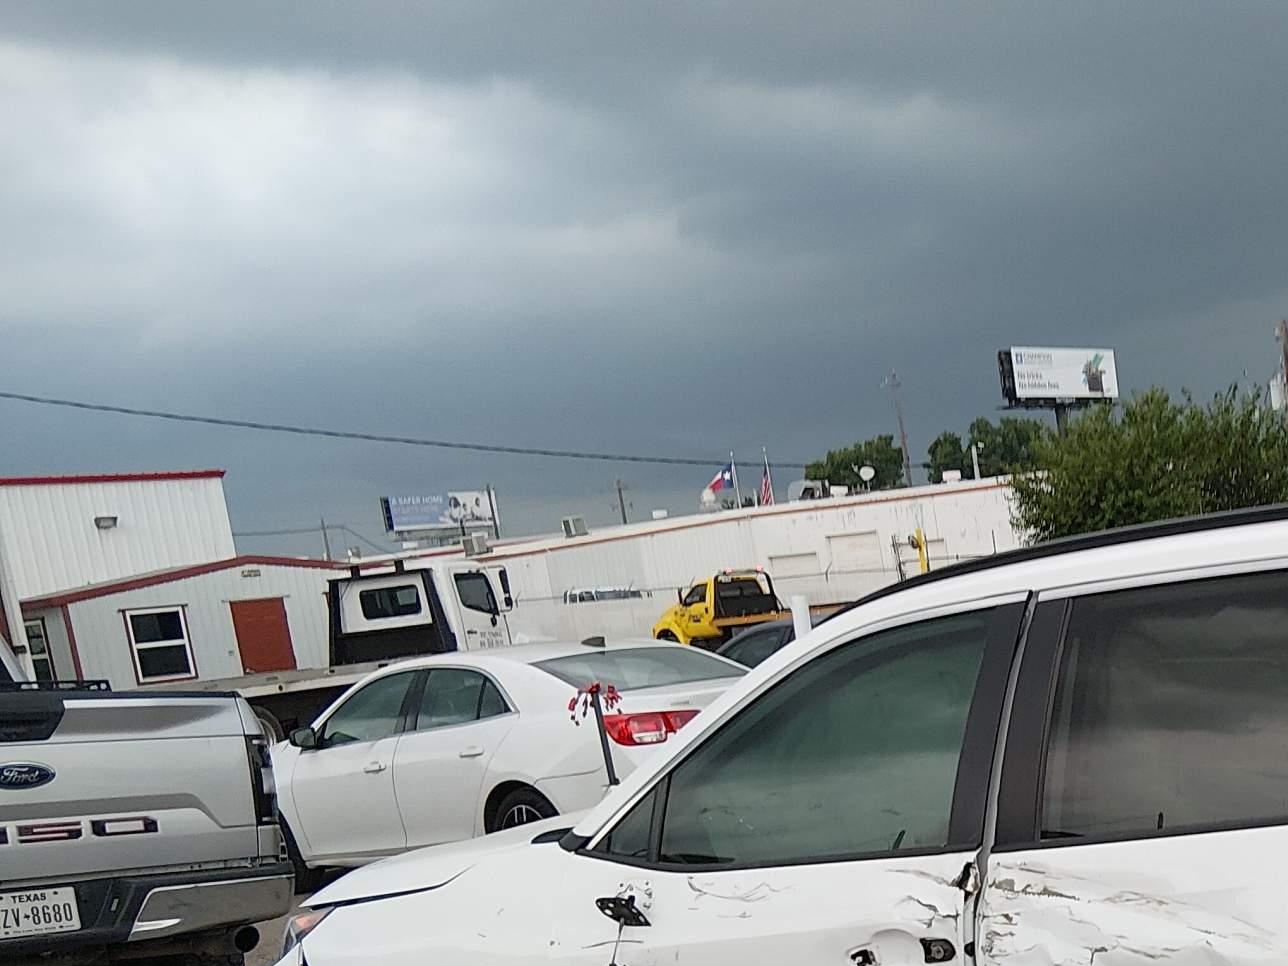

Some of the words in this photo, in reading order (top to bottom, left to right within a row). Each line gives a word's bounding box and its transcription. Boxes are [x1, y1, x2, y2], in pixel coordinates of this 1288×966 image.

[1, 767, 40, 783] Ford
[0, 816, 159, 845] 50
[11, 893, 47, 904] TEXAS
